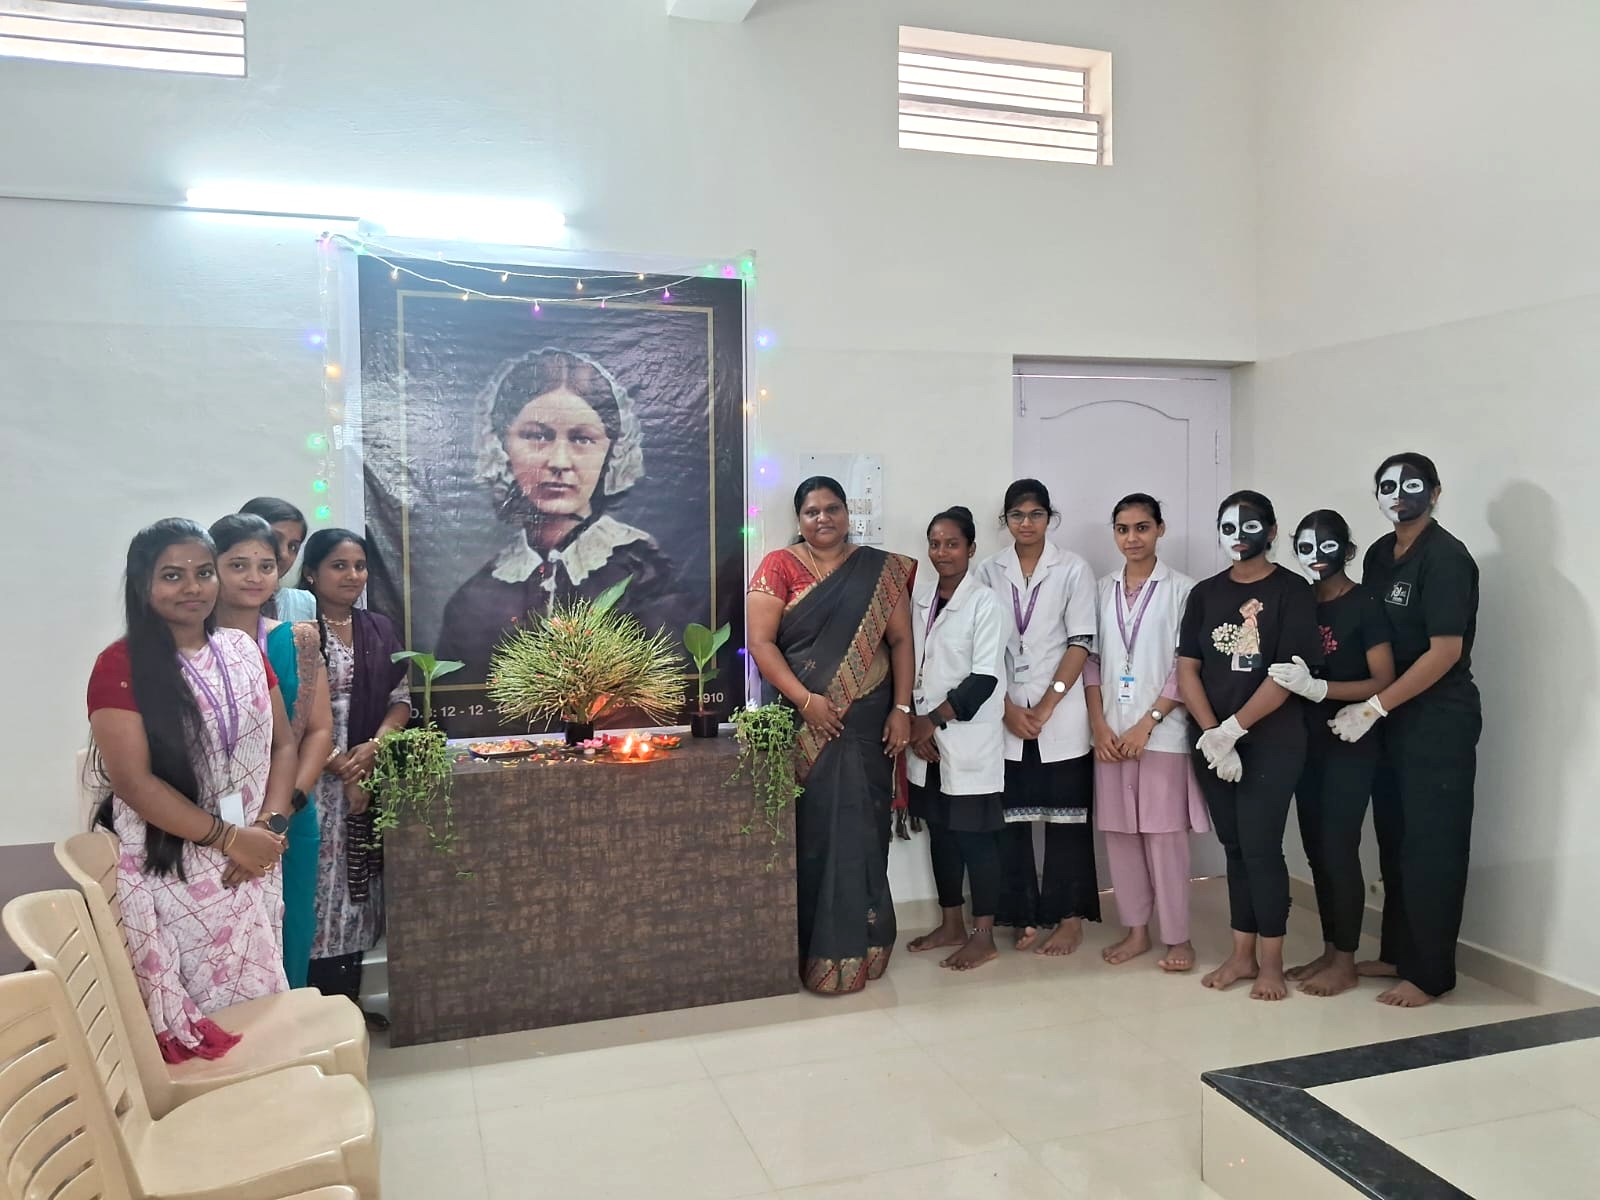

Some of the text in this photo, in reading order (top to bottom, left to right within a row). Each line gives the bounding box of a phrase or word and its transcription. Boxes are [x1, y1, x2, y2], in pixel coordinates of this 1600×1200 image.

[697, 692, 724, 704] 910
[440, 706, 456, 717] 12
[468, 704, 484, 716] 12
